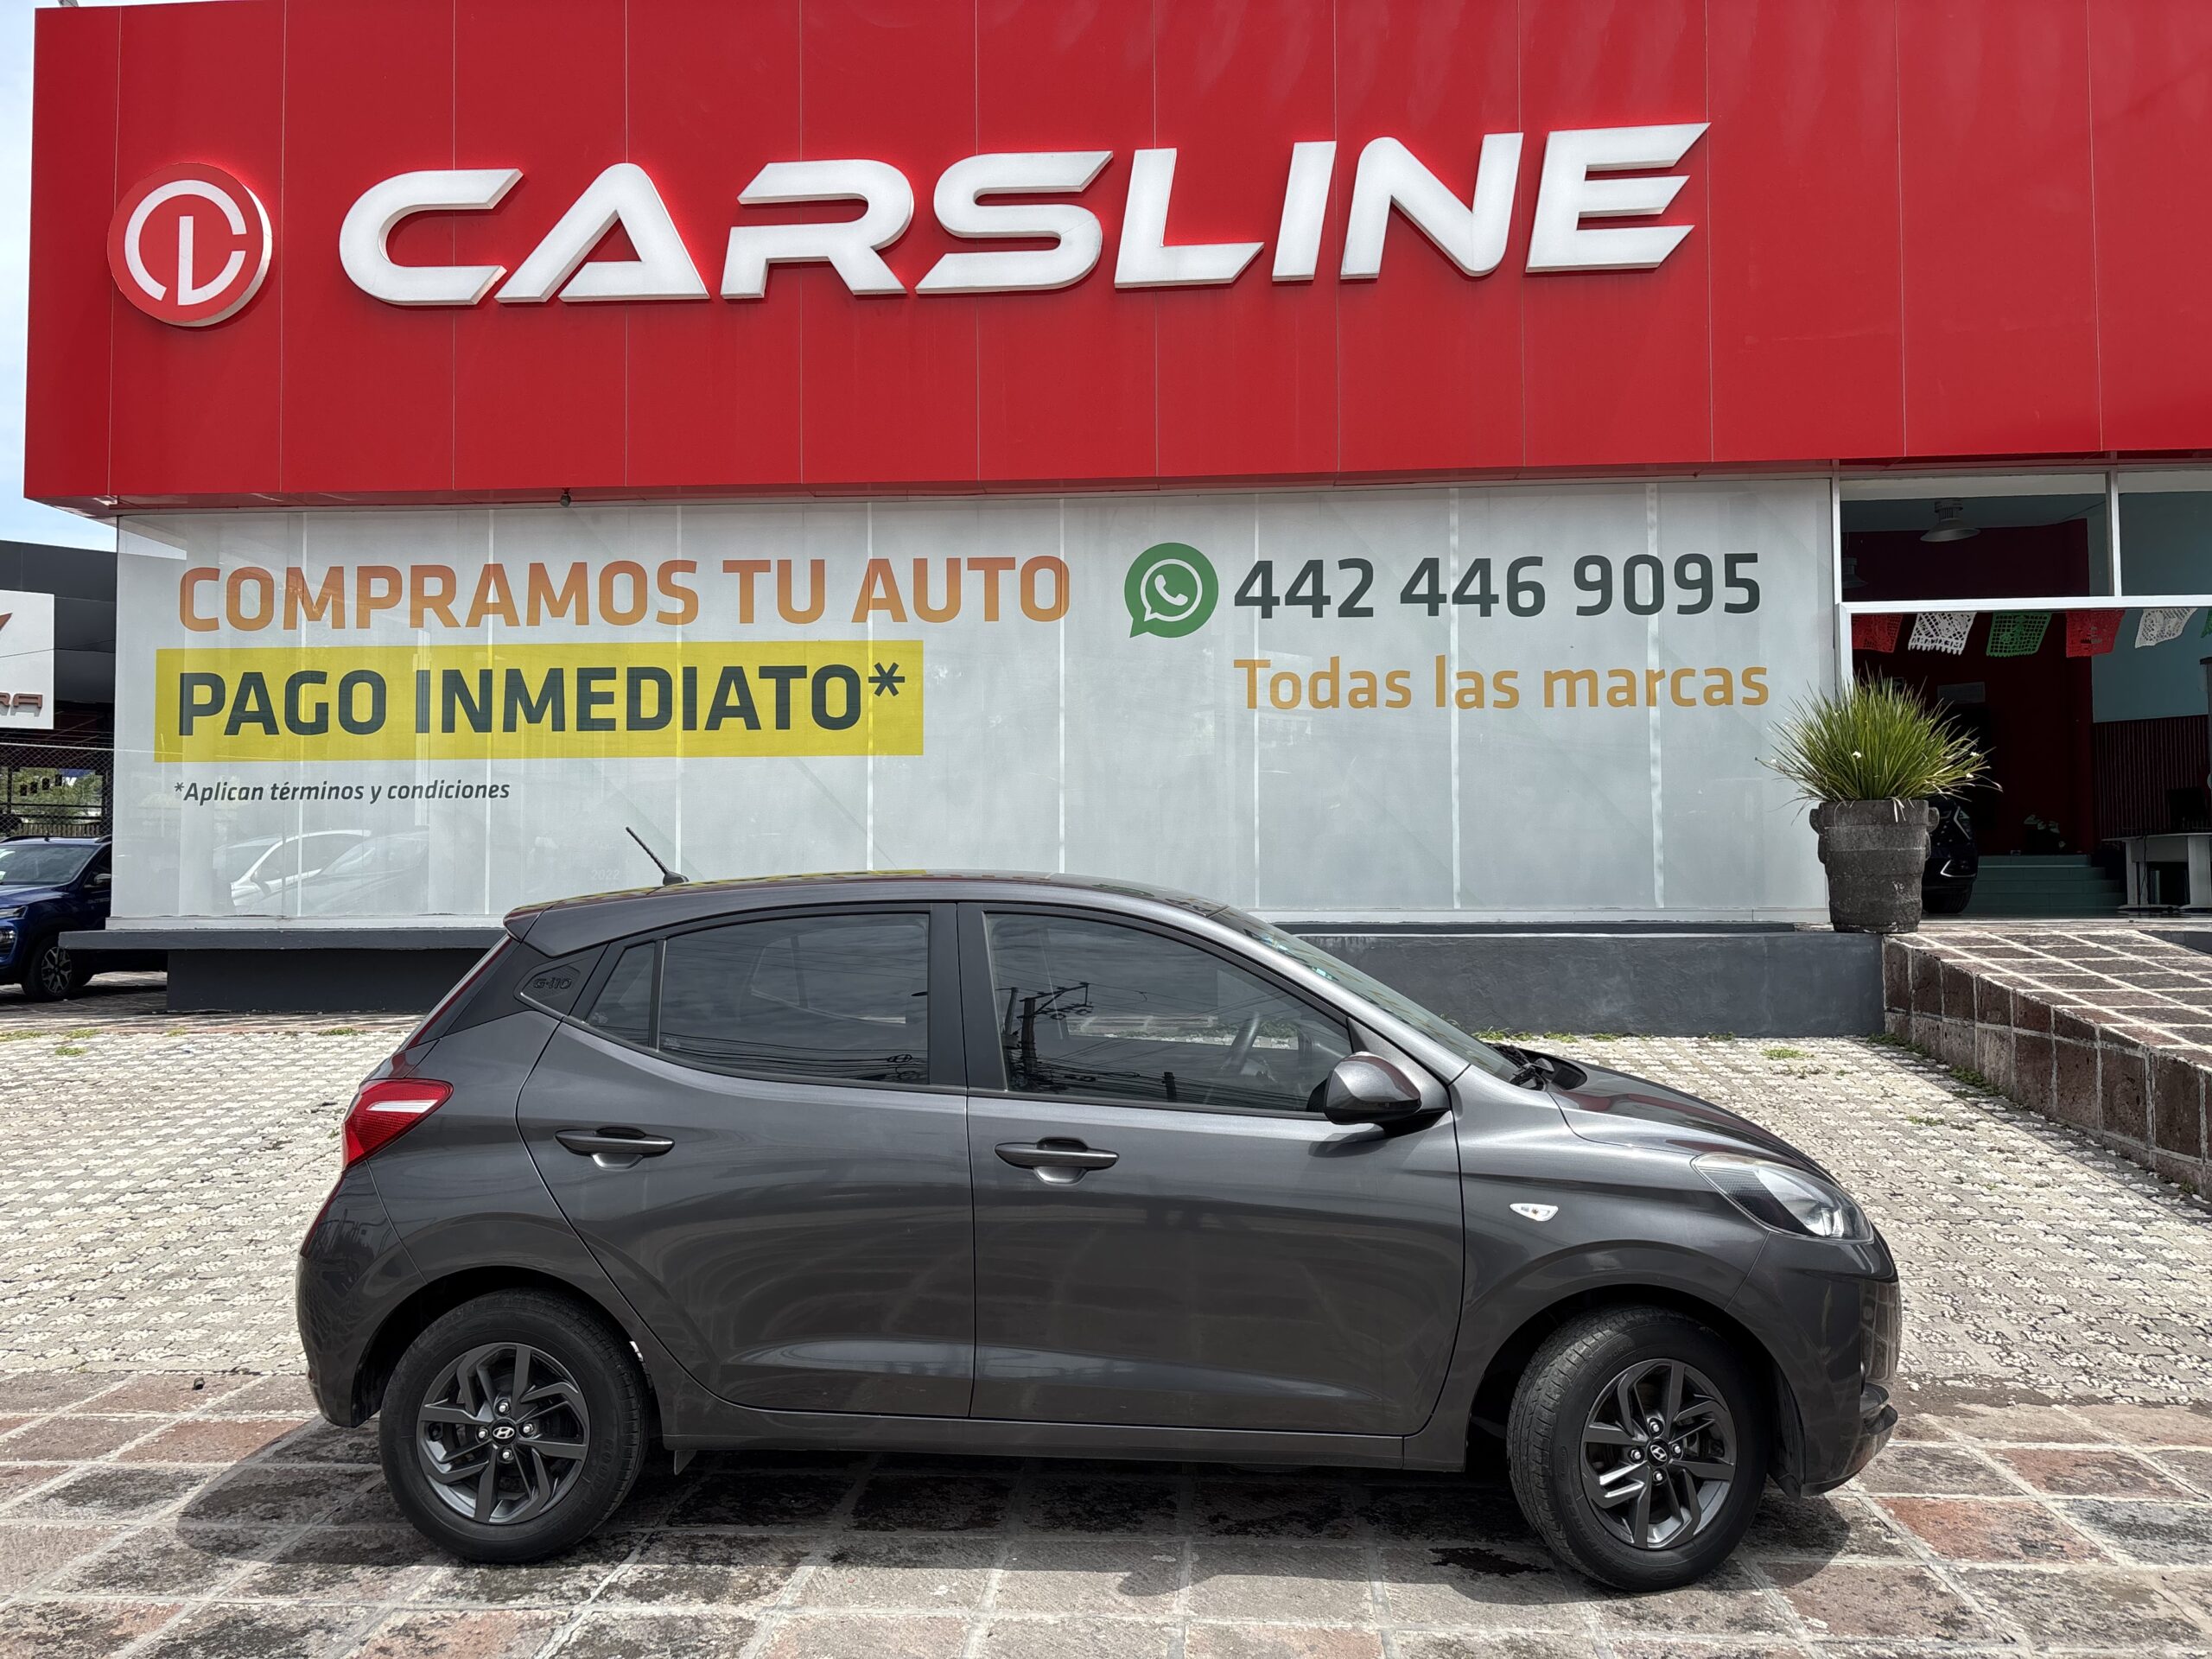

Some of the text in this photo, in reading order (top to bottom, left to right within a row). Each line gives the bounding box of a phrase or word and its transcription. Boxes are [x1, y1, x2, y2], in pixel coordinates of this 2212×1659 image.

[339, 122, 1711, 305] CARSLINE
[179, 556, 1070, 632] COMPRAMOS TU AUTO
[1234, 552, 1761, 620] 442 446 9095
[178, 669, 387, 736] PAGO
[1233, 655, 1769, 709] Todas las marcas
[270, 779, 365, 801] términos
[370, 785, 382, 804] y
[387, 779, 511, 799] condiciones
